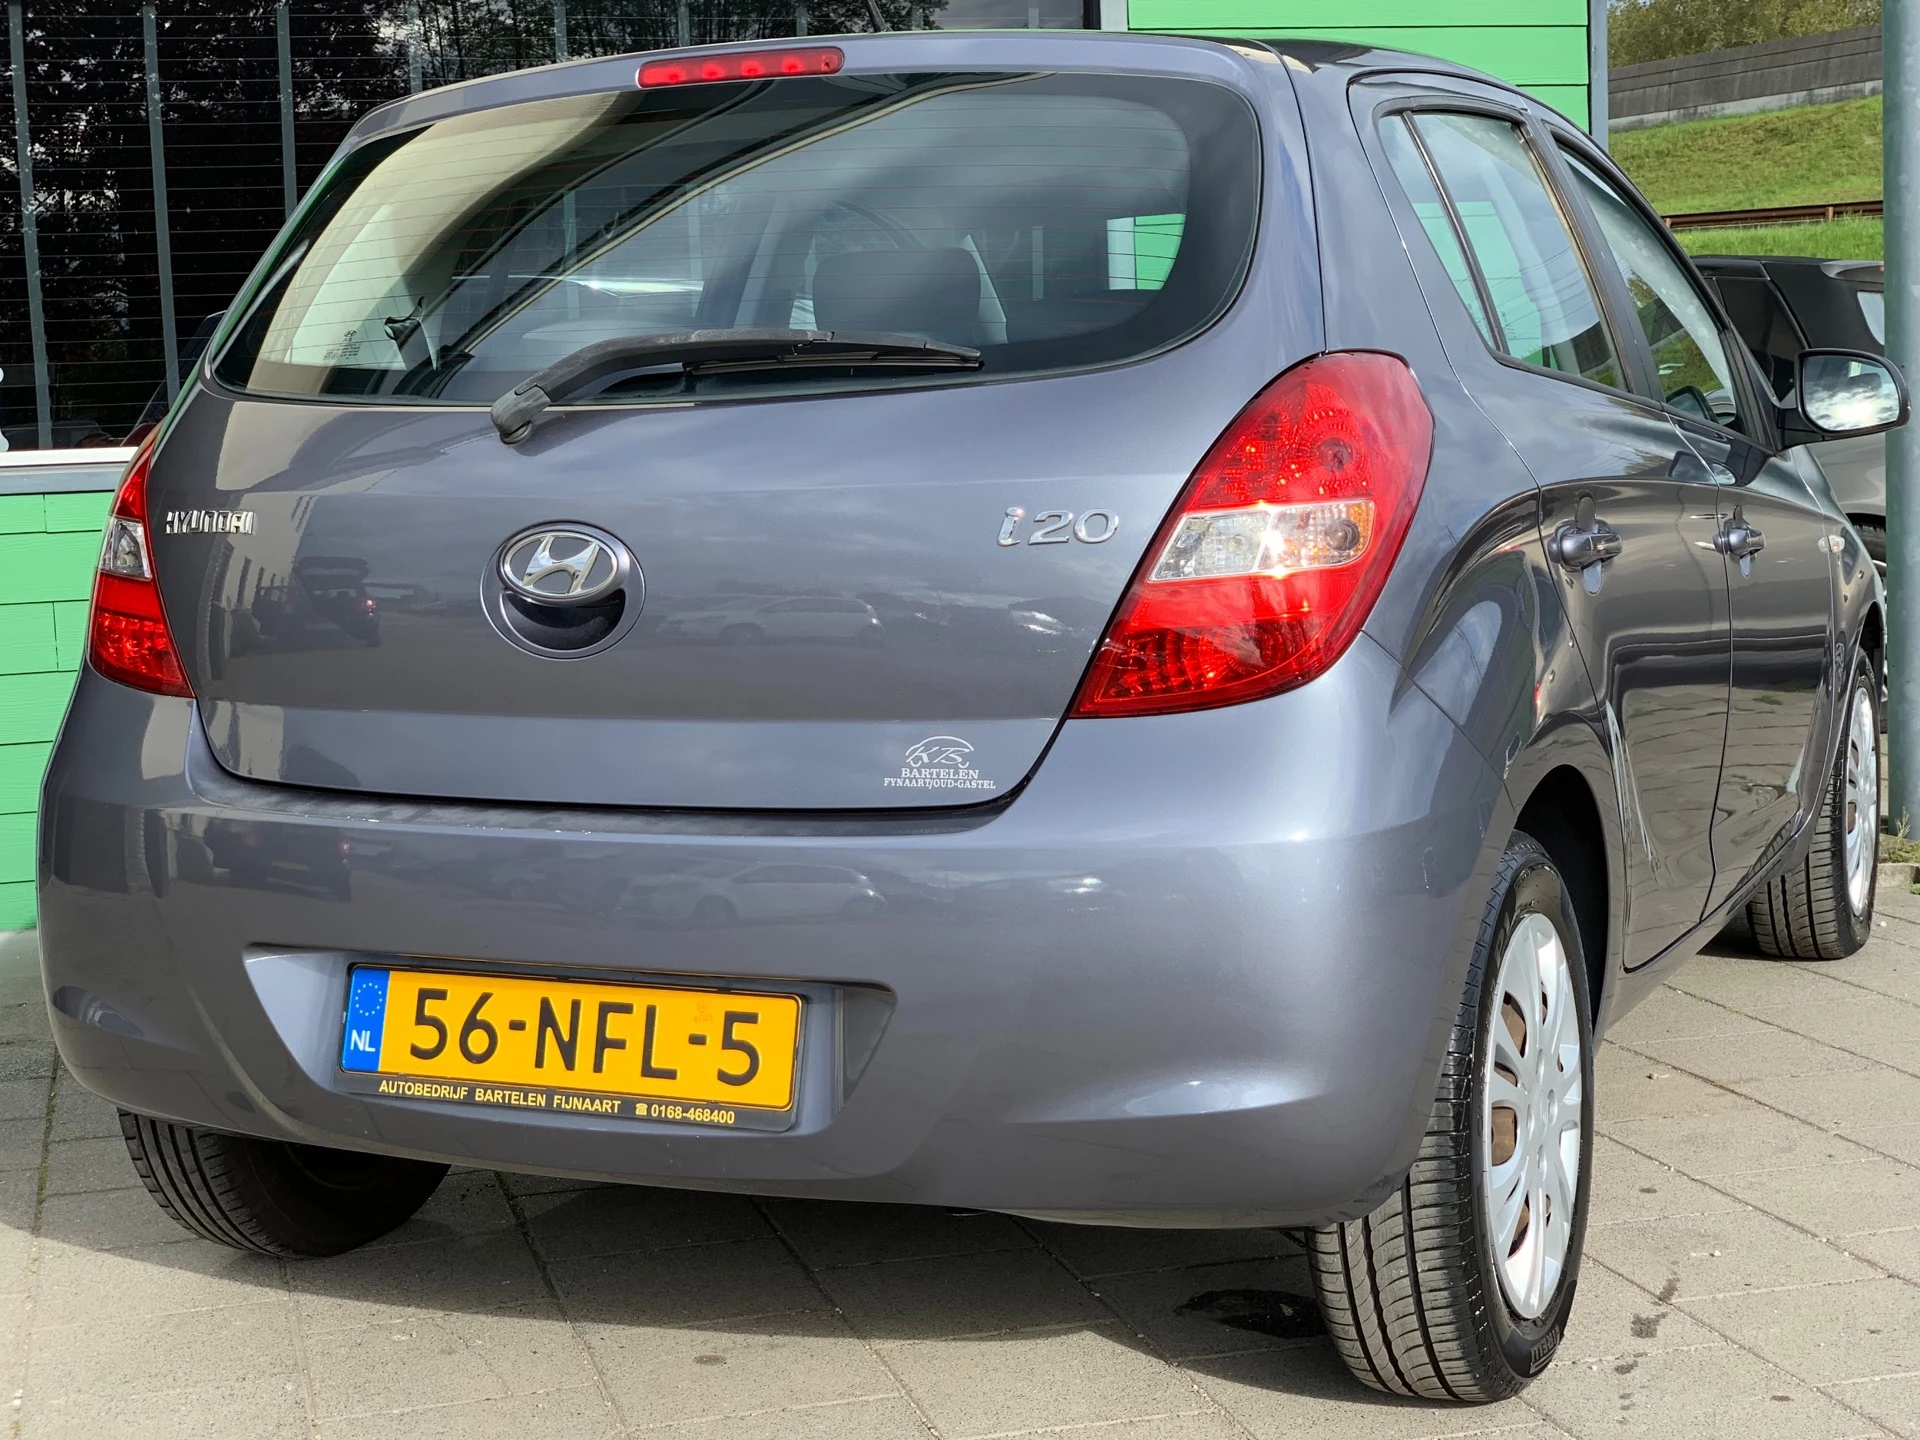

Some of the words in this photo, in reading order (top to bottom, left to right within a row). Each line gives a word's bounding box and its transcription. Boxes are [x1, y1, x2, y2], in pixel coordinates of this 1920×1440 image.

[166, 510, 256, 535] HYUNDAI
[997, 506, 1120, 547] i20
[883, 777, 996, 789] FYNAART/OUD-GASTEL
[900, 767, 979, 779] BARTELEN
[350, 1028, 376, 1053] NL
[408, 987, 761, 1087] 56-NFL-5
[378, 1079, 469, 1100] AUTOBEDRIJF
[474, 1088, 547, 1108] BARTELEN
[552, 1095, 622, 1114] FIJNAART
[650, 1105, 736, 1125] 0168-468400
